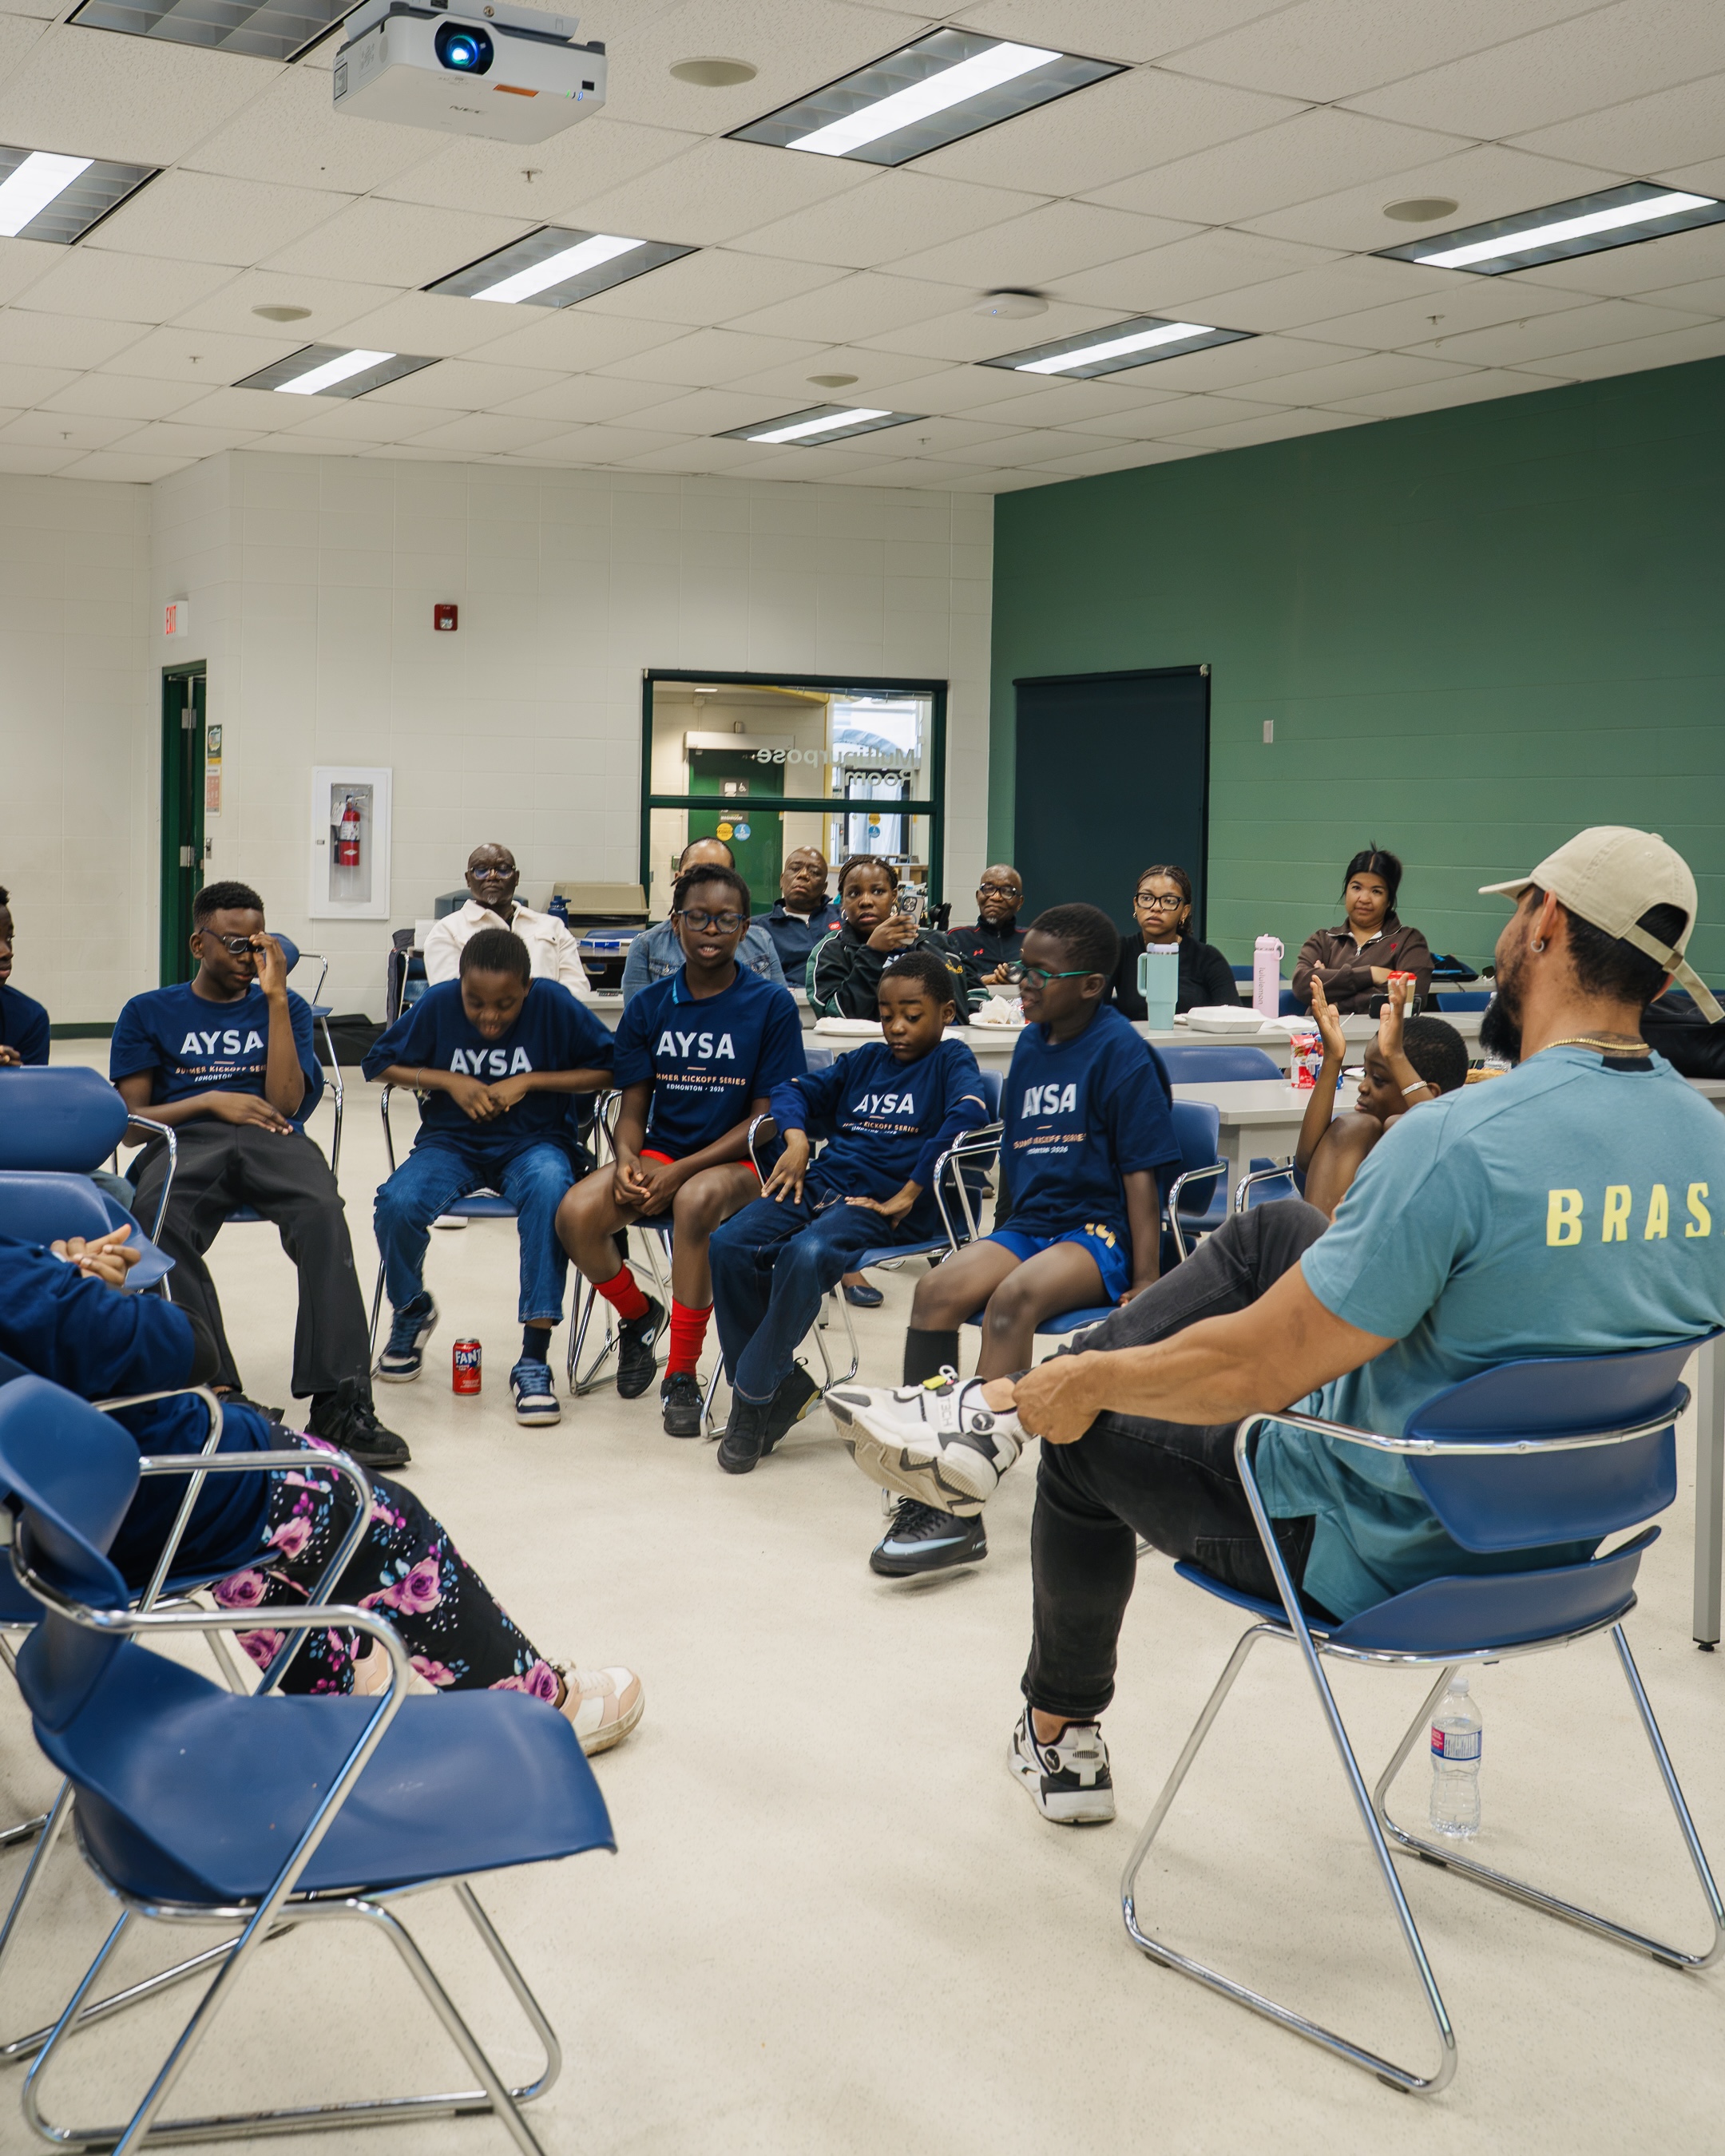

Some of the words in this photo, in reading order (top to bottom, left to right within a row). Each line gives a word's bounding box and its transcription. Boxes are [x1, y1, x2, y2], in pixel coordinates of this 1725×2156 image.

[166, 604, 176, 635] EXIT
[180, 1029, 264, 1055] AYSA
[656, 1031, 736, 1060] AYSA
[450, 1046, 533, 1076] AYSA
[681, 1074, 717, 1084] KICKOFF
[719, 1076, 747, 1086] SERIES
[852, 1093, 914, 1115] AYSA
[1021, 1084, 1077, 1120] AYSA
[864, 1121, 893, 1131] KICKOFF
[1546, 1182, 1725, 1246] BRAS
[455, 1348, 482, 1365] FANT
